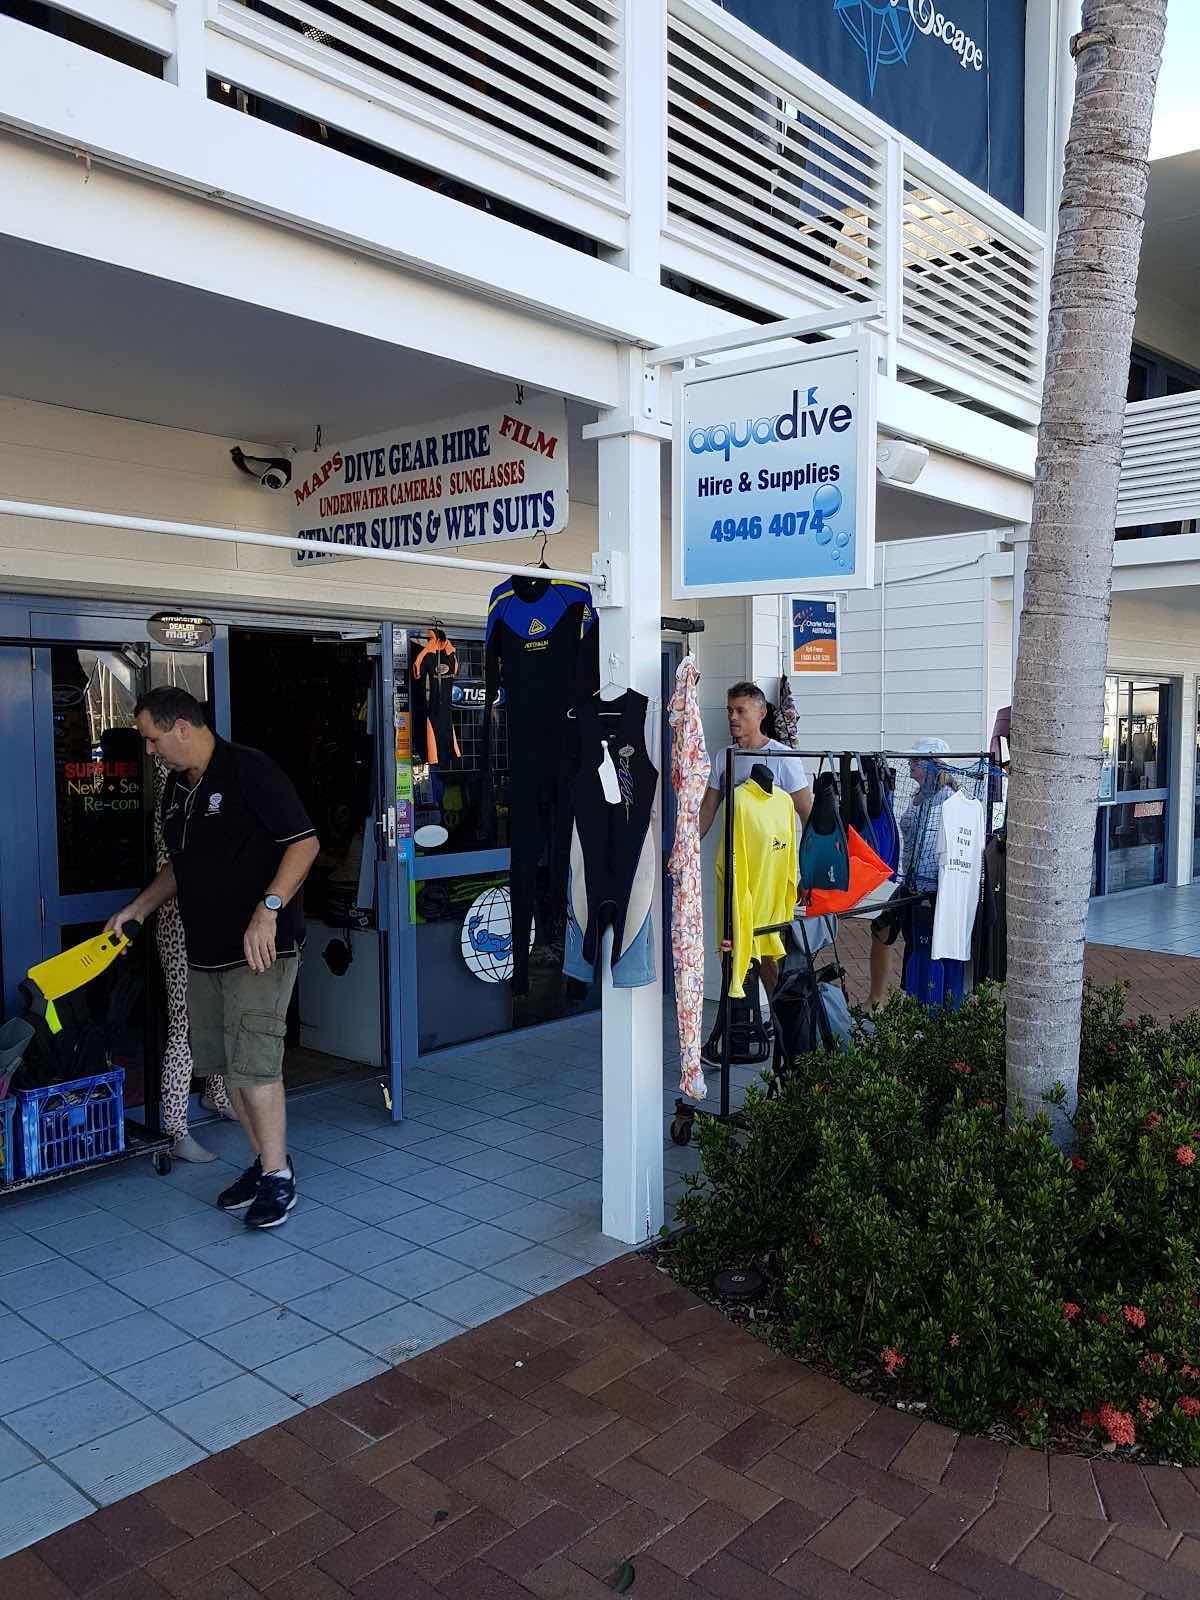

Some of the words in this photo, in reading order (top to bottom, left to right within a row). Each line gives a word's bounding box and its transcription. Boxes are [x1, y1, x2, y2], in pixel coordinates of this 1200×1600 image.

[499, 414, 558, 460] FILM
[688, 387, 852, 462] aquadive
[344, 449, 386, 484] DIVE
[389, 433, 440, 475] GEAR
[441, 424, 491, 463] HIRE
[294, 451, 343, 506] MAPS
[319, 490, 390, 518] UNDERWATER
[391, 475, 442, 505] CAMERAS
[449, 459, 525, 496] SUNGLASSES
[698, 478, 733, 497] Hire
[739, 471, 752, 492] &
[758, 463, 840, 492] Supplies
[370, 511, 422, 550] SUITS
[426, 509, 441, 543] &
[444, 501, 489, 541] WET
[492, 490, 555, 535] SUITS
[710, 515, 762, 543] 4946
[768, 510, 824, 537] 4074
[165, 630, 199, 640] mares
[169, 622, 195, 630] DEALER
[463, 688, 486, 701] TUS
[64, 761, 137, 778] SUPPLIES
[67, 780, 104, 795] New
[119, 779, 139, 793] Se
[84, 797, 139, 811] Re-con
